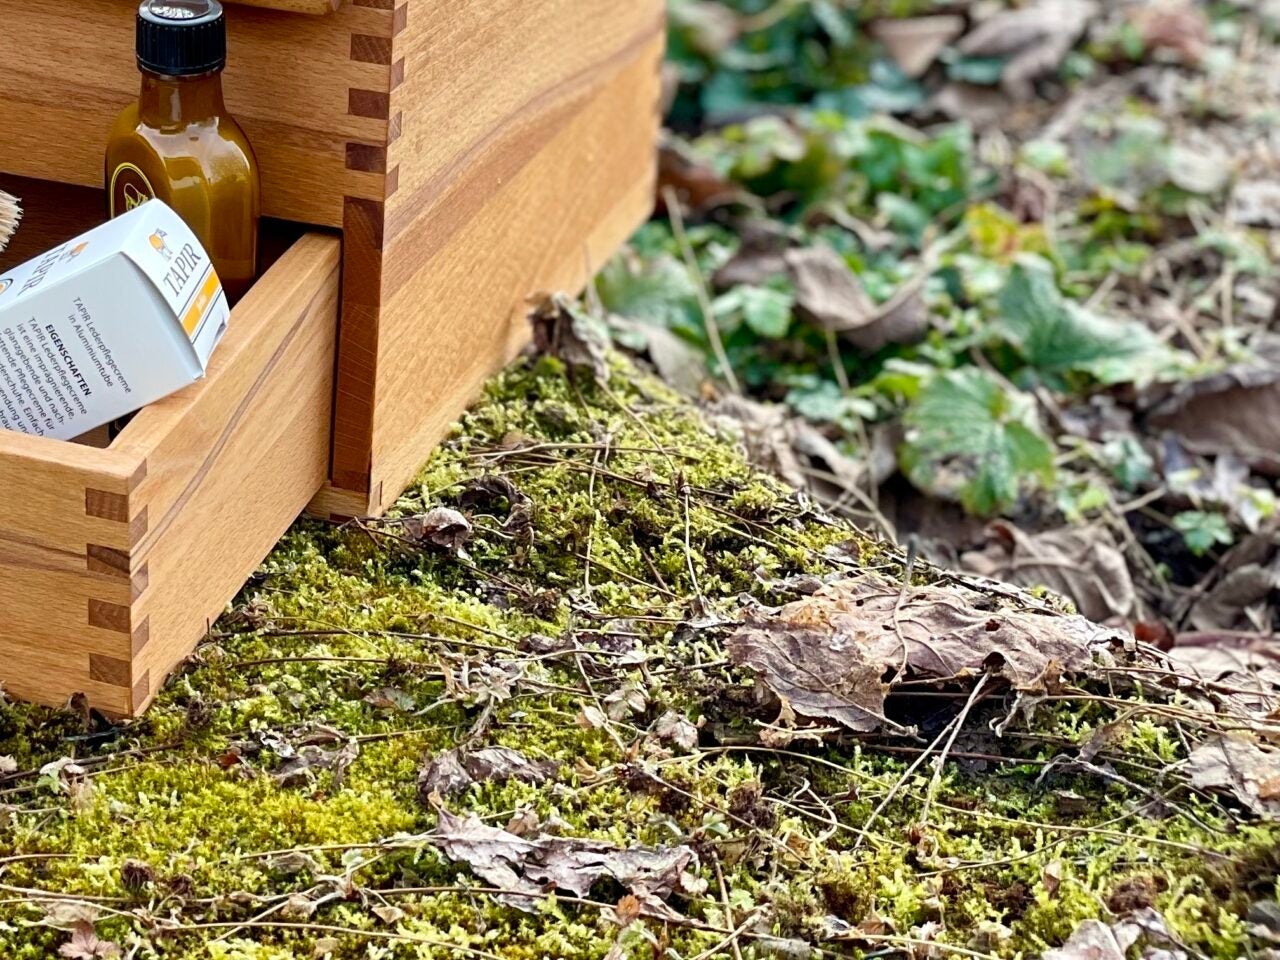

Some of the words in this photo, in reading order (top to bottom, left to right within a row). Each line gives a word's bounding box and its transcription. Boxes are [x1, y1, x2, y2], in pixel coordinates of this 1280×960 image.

[162, 242, 201, 297] TAPIR
[2, 325, 42, 386] glanzgebende
[37, 383, 52, 402] und
[48, 401, 67, 426] nach-
[15, 322, 27, 334] ist
[22, 333, 37, 353] eine
[31, 352, 76, 420] imprägnierende,
[27, 317, 46, 342] TAPIR
[40, 341, 88, 416] Lederpflegecreme
[44, 323, 91, 396] EIGENSCHAFTEN
[67, 313, 77, 323] in
[72, 322, 115, 388] Aluminiumtube
[72, 296, 91, 321] TAPIR
[85, 320, 132, 394] Lederpflegecreme
[12, 366, 48, 419] Pflegecreme
[43, 416, 56, 431] für
[22, 405, 45, 437] Einfach
